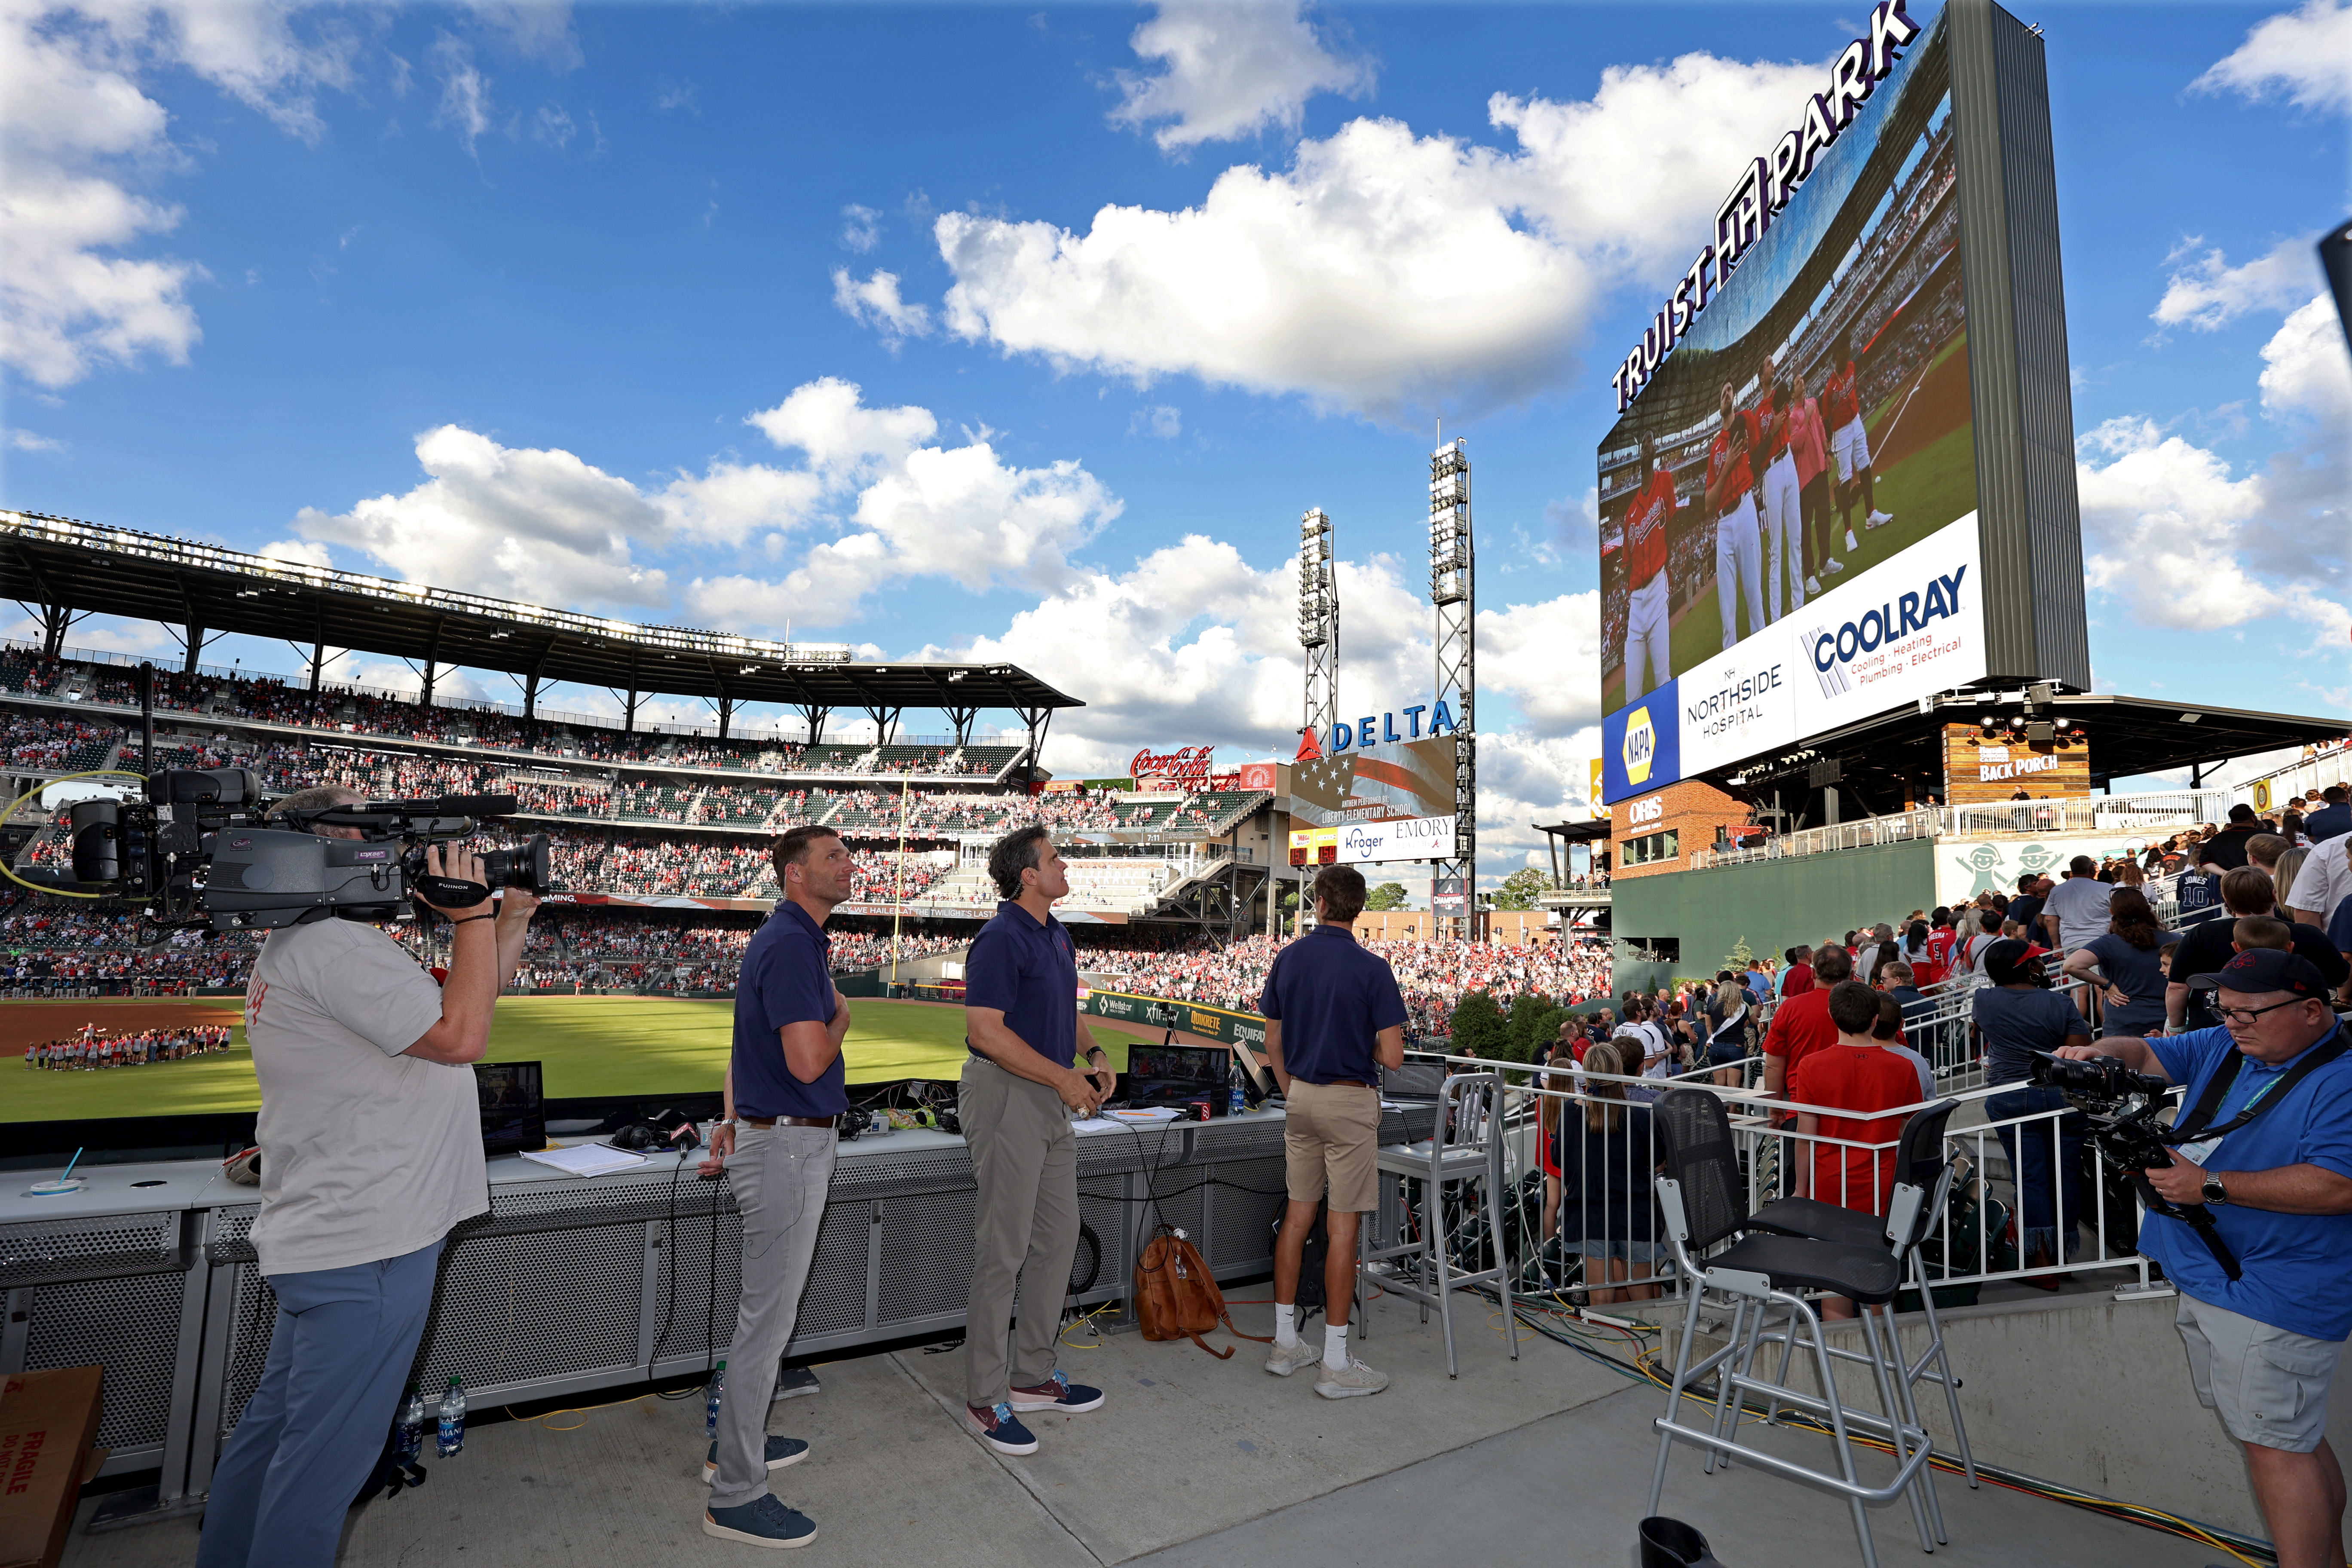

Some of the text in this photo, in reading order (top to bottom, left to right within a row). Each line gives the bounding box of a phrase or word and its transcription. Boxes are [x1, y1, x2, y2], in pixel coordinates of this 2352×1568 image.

[1612, 0, 1921, 413] TRUIST PARK
[1815, 564, 1967, 672] COOLRAY
[1851, 634, 1932, 674] Cooling Heating
[1860, 636, 1961, 686] Plumbing Electrical
[1688, 663, 1782, 725] NORTHSIDE
[1331, 701, 1455, 752] DELTA
[1703, 704, 1763, 739] HOSPITAL
[1628, 726, 1650, 765] NAPA
[1130, 745, 1215, 778] Coca-Cola
[1979, 755, 2058, 781] BACK PORCH
[1342, 799, 1357, 808] ANTHEM
[1358, 796, 1381, 806] PERFORMED
[1629, 796, 1662, 824] ORIS
[1322, 803, 1412, 824] LIBERTY ELEMENTARY SCHOOL
[2118, 813, 2177, 828] Welcome
[908, 831, 919, 840] 44
[927, 832, 936, 840] 47
[947, 833, 959, 842] 42
[1396, 818, 1452, 838] EMORY
[1320, 846, 1335, 858] 150
[1346, 828, 1384, 858] Kroger
[1292, 848, 1305, 859] 157
[2166, 861, 2175, 872] 3
[1089, 870, 1148, 885] TERRACE
[2184, 876, 2208, 885] JONES
[1433, 896, 1464, 905] CHAMPIONS
[2183, 887, 2209, 907] 10
[930, 909, 972, 917] TWILIGHT'S
[1933, 943, 1942, 959] 5
[1109, 1000, 1132, 1011] Wellstar
[1146, 1002, 1179, 1024] xfiny
[1191, 1011, 1220, 1030] QUIKRETE
[2, 1434, 20, 1449] DO
[438, 1426, 462, 1438] DASANI
[6, 1430, 47, 1496] FRAGILE
